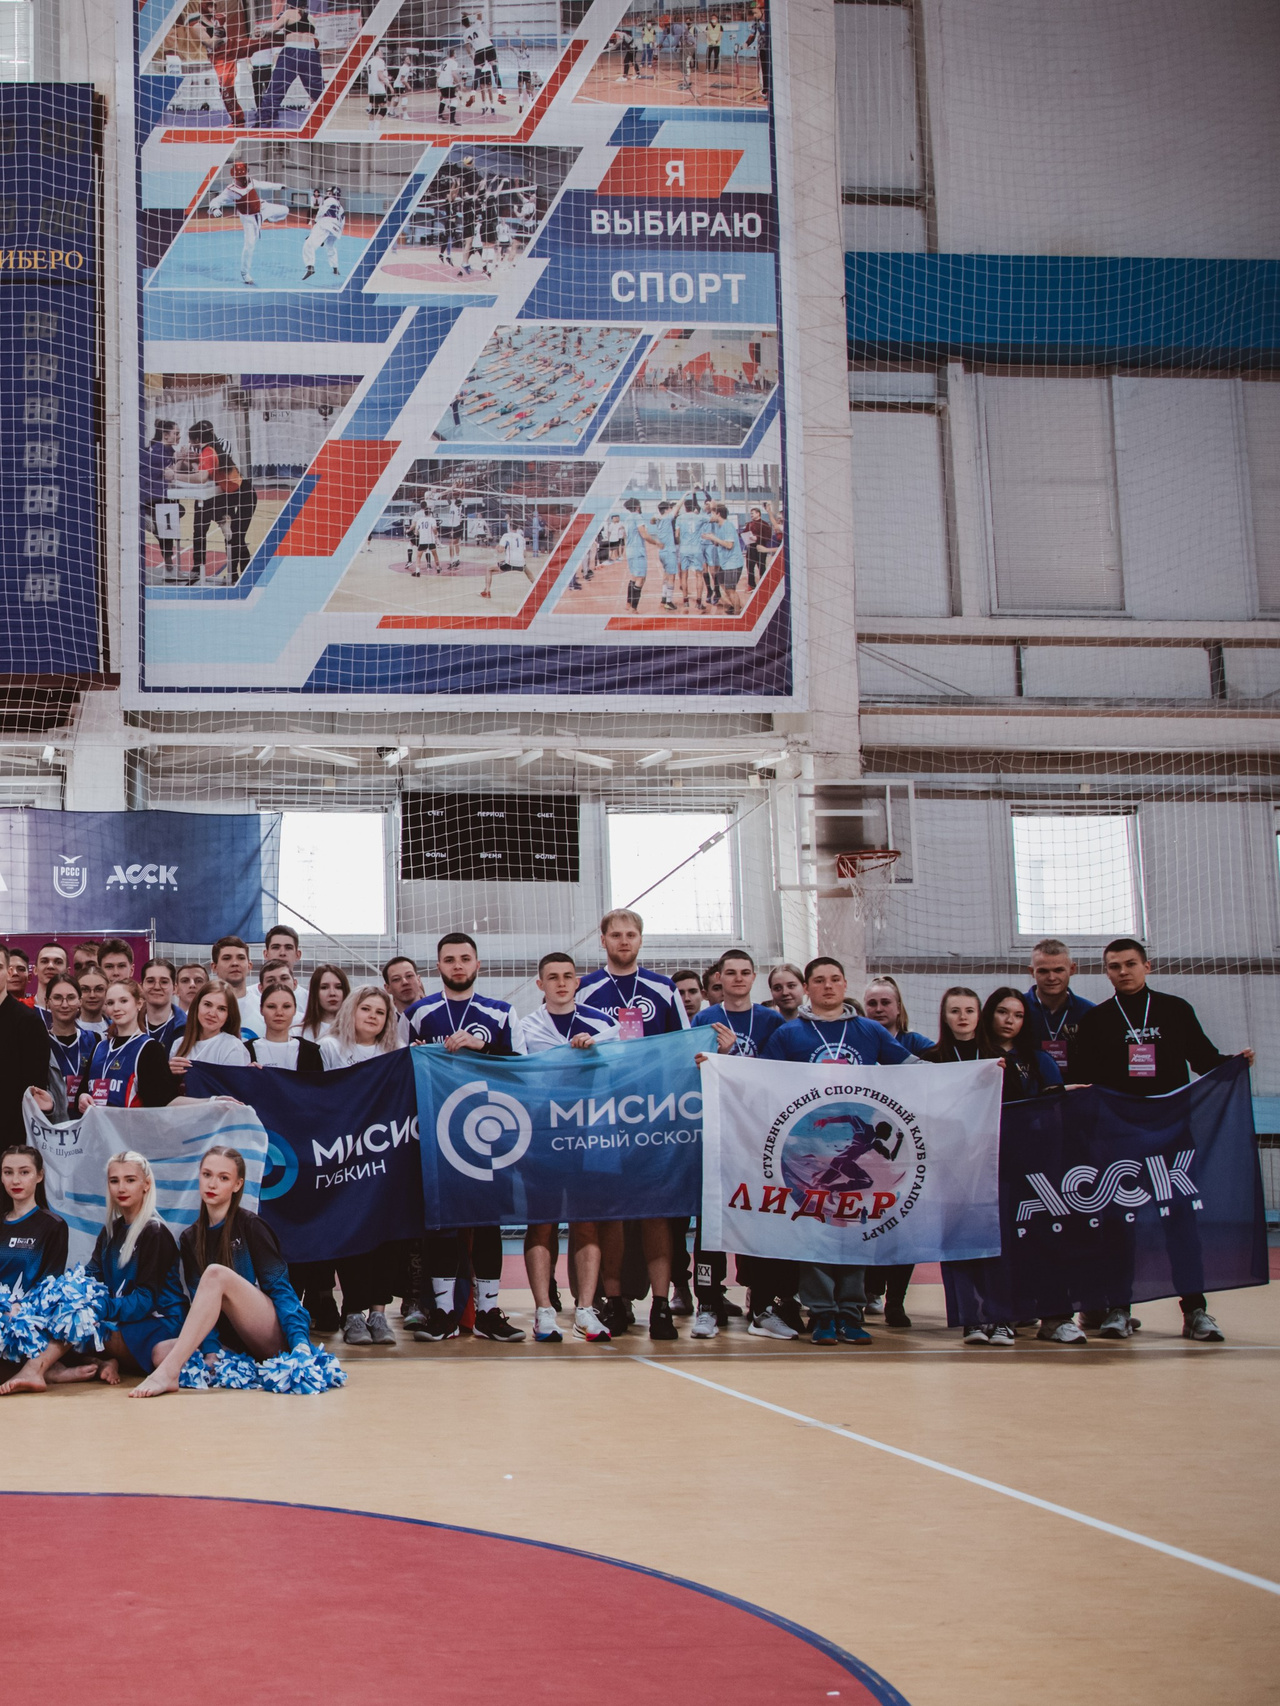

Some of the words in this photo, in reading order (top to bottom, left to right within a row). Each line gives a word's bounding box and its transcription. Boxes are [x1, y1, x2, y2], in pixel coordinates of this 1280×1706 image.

[665, 160, 685, 187] Я
[591, 211, 762, 238] ВЫБИРАЮ
[611, 271, 746, 305] СПОРТ
[163, 511, 173, 531] 1
[106, 863, 179, 885] АССК
[550, 1091, 703, 1129] МИСИС
[824, 1085, 916, 1127] СПОРТИВНЫЙ
[551, 1131, 630, 1151] СТАРЫЙ
[634, 1129, 703, 1147] ОСКОЛ
[763, 1087, 822, 1179] СТУДЕНЧЕСКИЙ
[909, 1125, 927, 1161] КЛУБ
[315, 1159, 386, 1190] ГУБКИН
[899, 1164, 927, 1219] ОГАПОУ
[1016, 1149, 1199, 1222] АССК
[728, 1182, 898, 1223] ЛИДЕР
[1016, 1199, 1204, 1238] РОССИИ
[861, 1216, 900, 1242] ШАРТ
